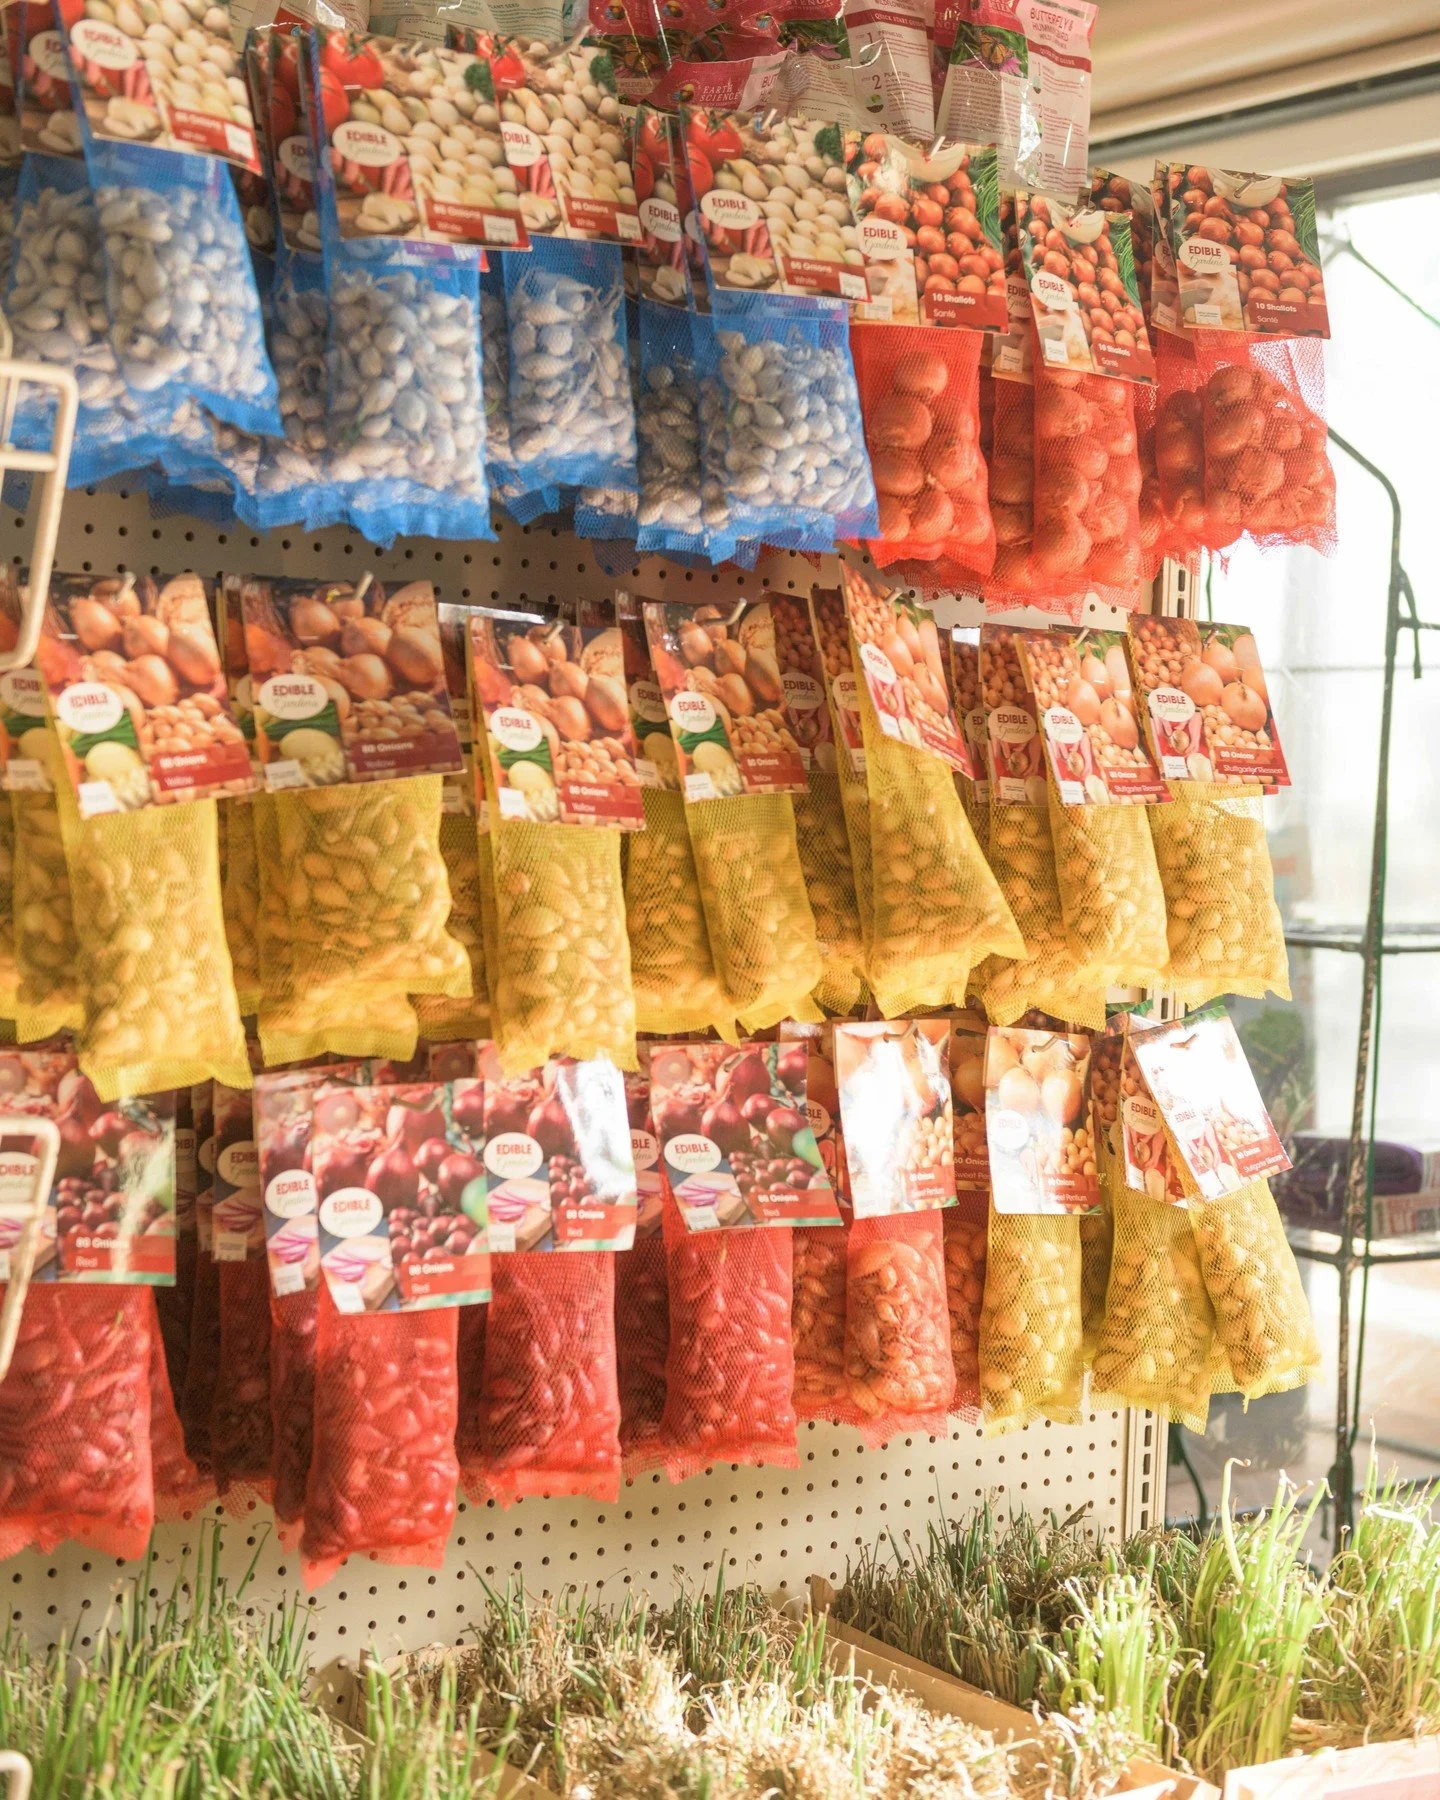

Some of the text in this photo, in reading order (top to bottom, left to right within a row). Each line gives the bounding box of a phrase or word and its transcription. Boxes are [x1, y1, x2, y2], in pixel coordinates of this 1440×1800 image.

[1030, 8, 1068, 28] BUTTERFLY
[703, 79, 733, 94] EARTH
[872, 74, 882, 89] 2
[700, 91, 740, 102] SCIENCE
[346, 130, 388, 146] EDIBLE
[502, 131, 532, 145] DIBLE
[711, 197, 748, 211] EDIBLE
[649, 206, 680, 223] EDIBLE
[863, 226, 898, 240] EDIBLE
[1188, 246, 1222, 258] EDIBLE
[1007, 281, 1031, 298] EDIB
[1038, 279, 1065, 293] EDIBLE
[932, 292, 976, 306] 10 Shallots
[933, 308, 956, 319] Santé
[1256, 302, 1297, 313] 10 Shallots
[1257, 315, 1279, 324] Santé
[1106, 344, 1131, 357] Shallots
[272, 684, 315, 696] EDIBLE
[784, 680, 816, 692] EDIBLE
[840, 681, 857, 691] EDIB
[69, 692, 108, 708] EDIBLE
[678, 700, 706, 711] EDIBLE
[1157, 694, 1185, 705] EDIBLE
[500, 717, 532, 729] EDIBLE
[997, 714, 1028, 725] EDIBLE
[1051, 715, 1074, 725] EDIBLE
[1231, 751, 1255, 760] Onions
[807, 1108, 822, 1119] BLE
[1131, 1102, 1157, 1119] EDIBLE
[496, 1144, 532, 1154] EDIBLE
[632, 1138, 650, 1149] BLE
[675, 1143, 710, 1154] EDIBLE
[230, 1151, 259, 1163] EDIB
[965, 1157, 990, 1166] Onion
[0, 1164, 36, 1176] DIBLE
[276, 1178, 310, 1195] EDIBLE
[333, 1199, 371, 1213] EDIBLE
